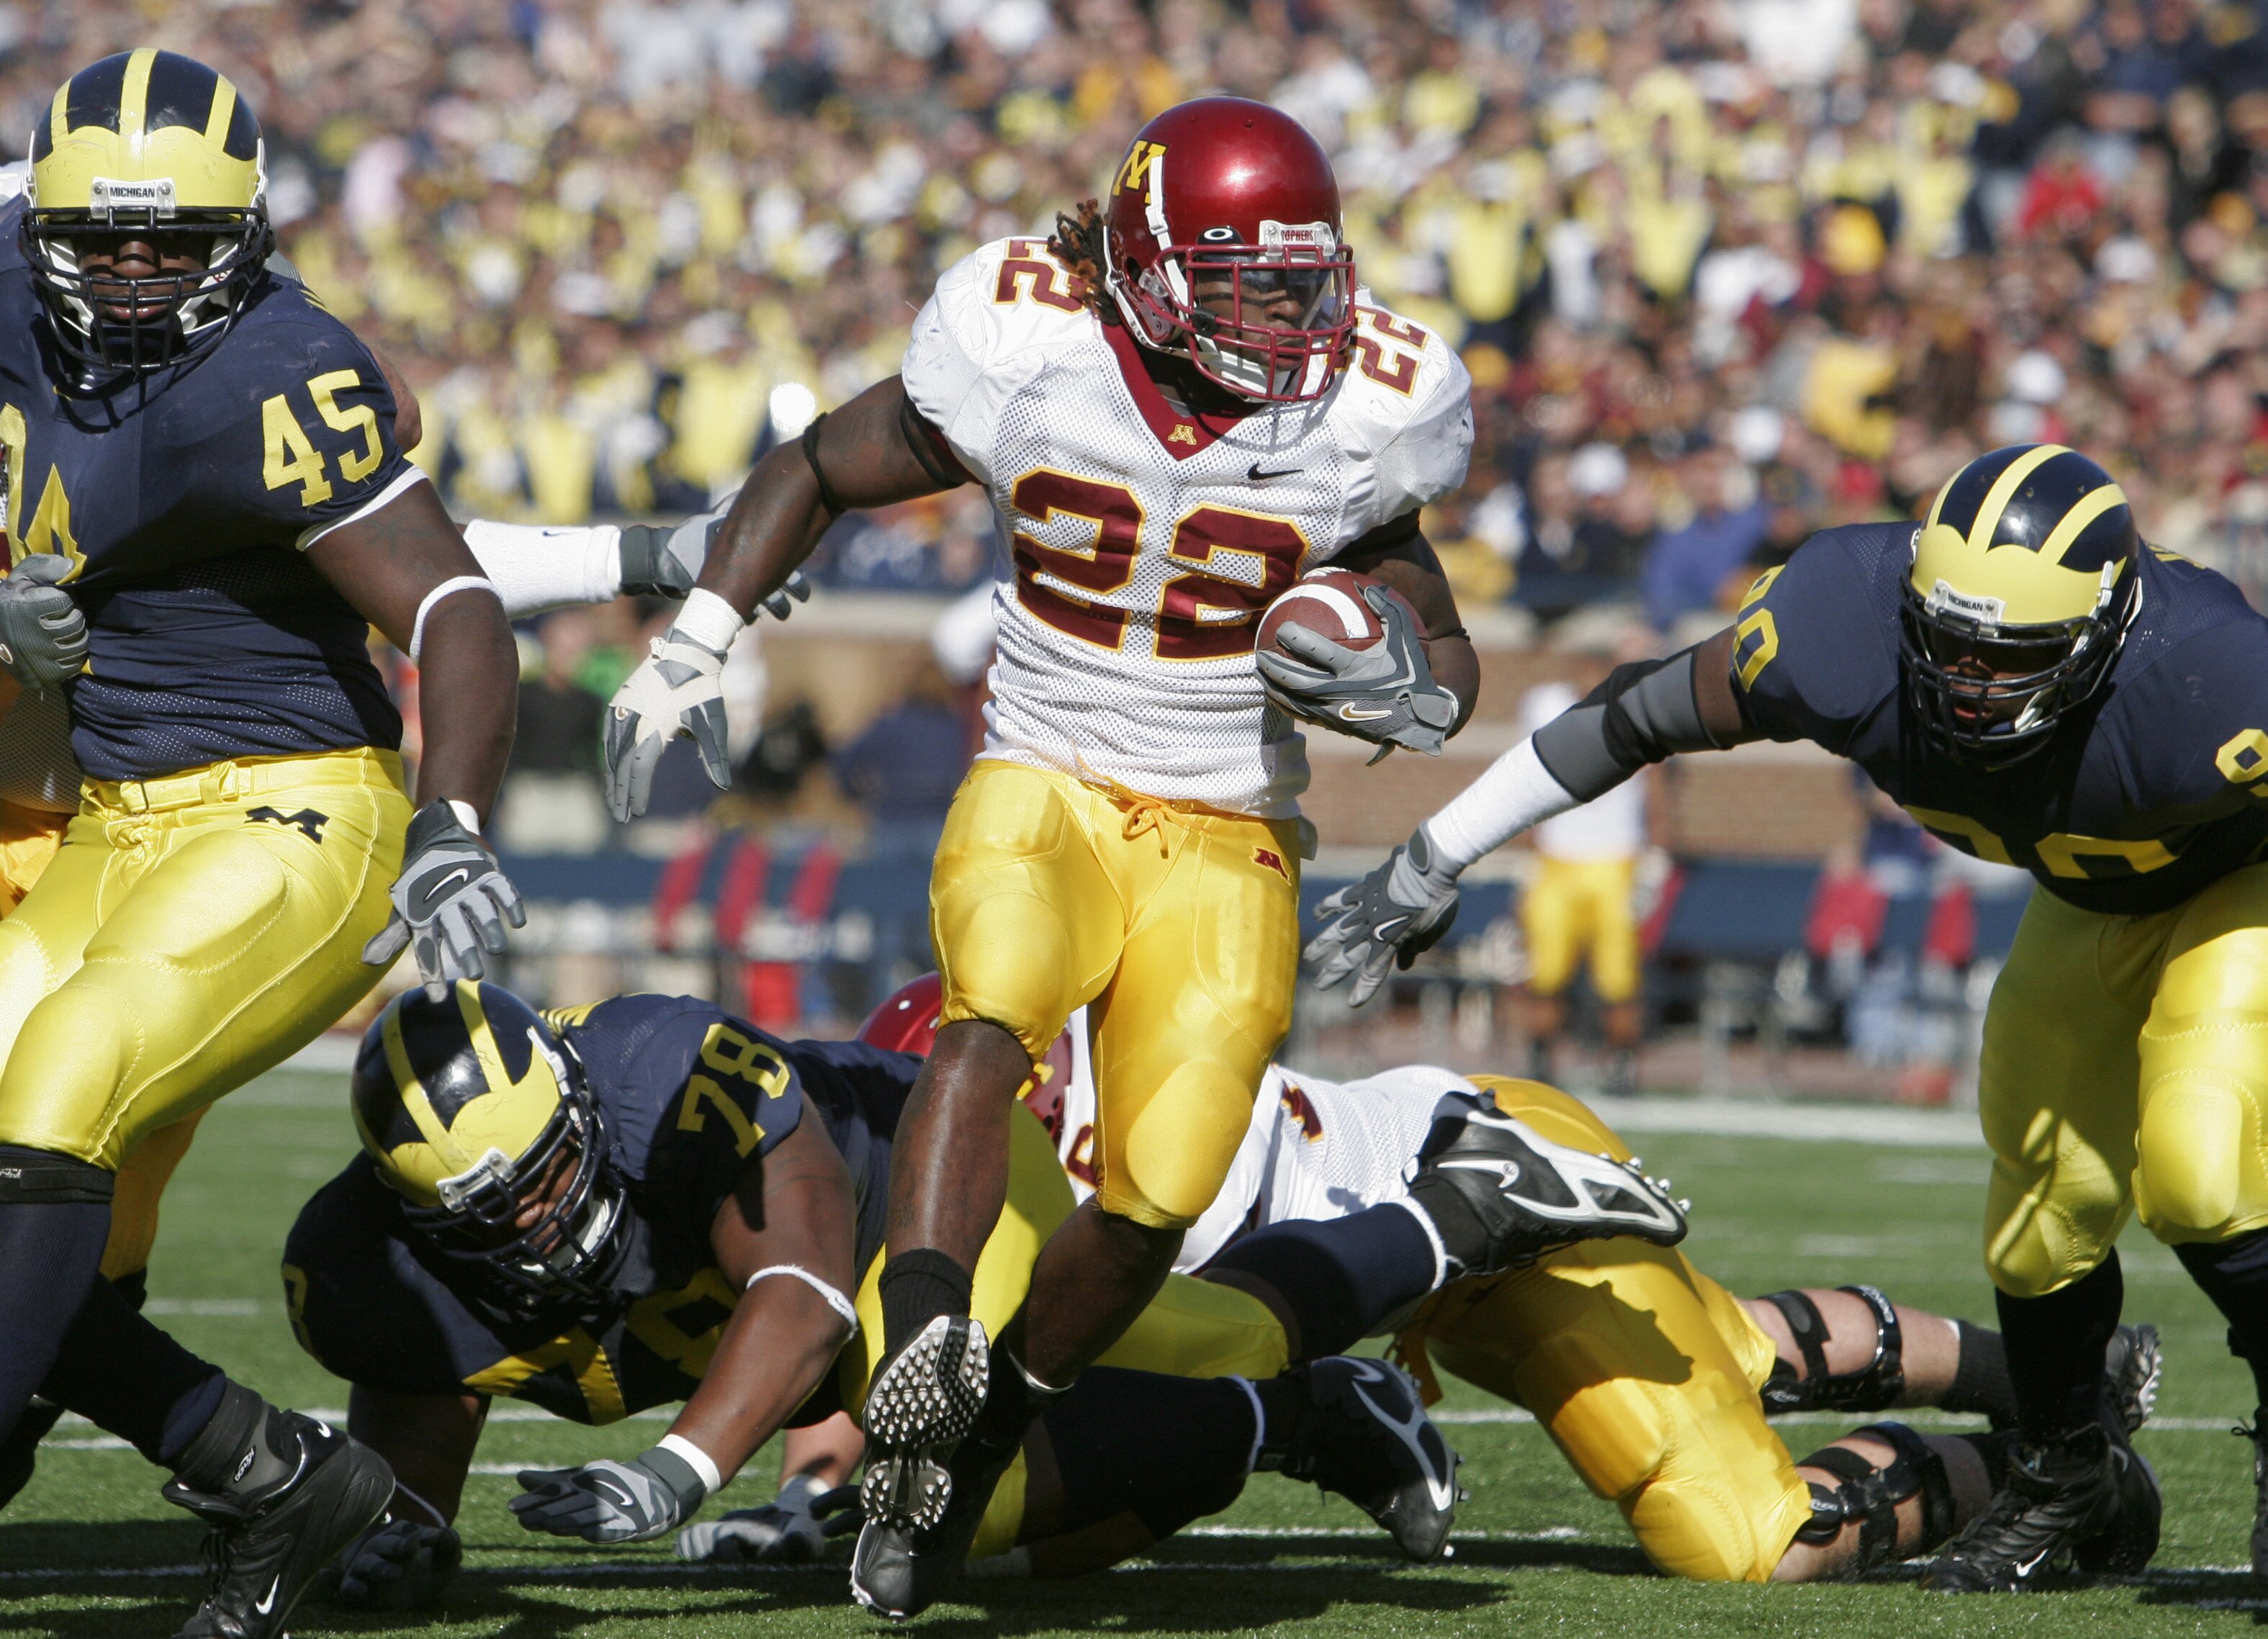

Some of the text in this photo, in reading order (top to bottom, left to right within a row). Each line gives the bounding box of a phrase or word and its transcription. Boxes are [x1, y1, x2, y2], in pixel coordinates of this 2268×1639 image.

[109, 186, 155, 198] MICHIGAN
[1323, 305, 1429, 399] 22
[262, 369, 384, 507] 45
[1010, 466, 1311, 664] 22
[243, 805, 330, 846] M
[677, 1022, 791, 1160] 78
